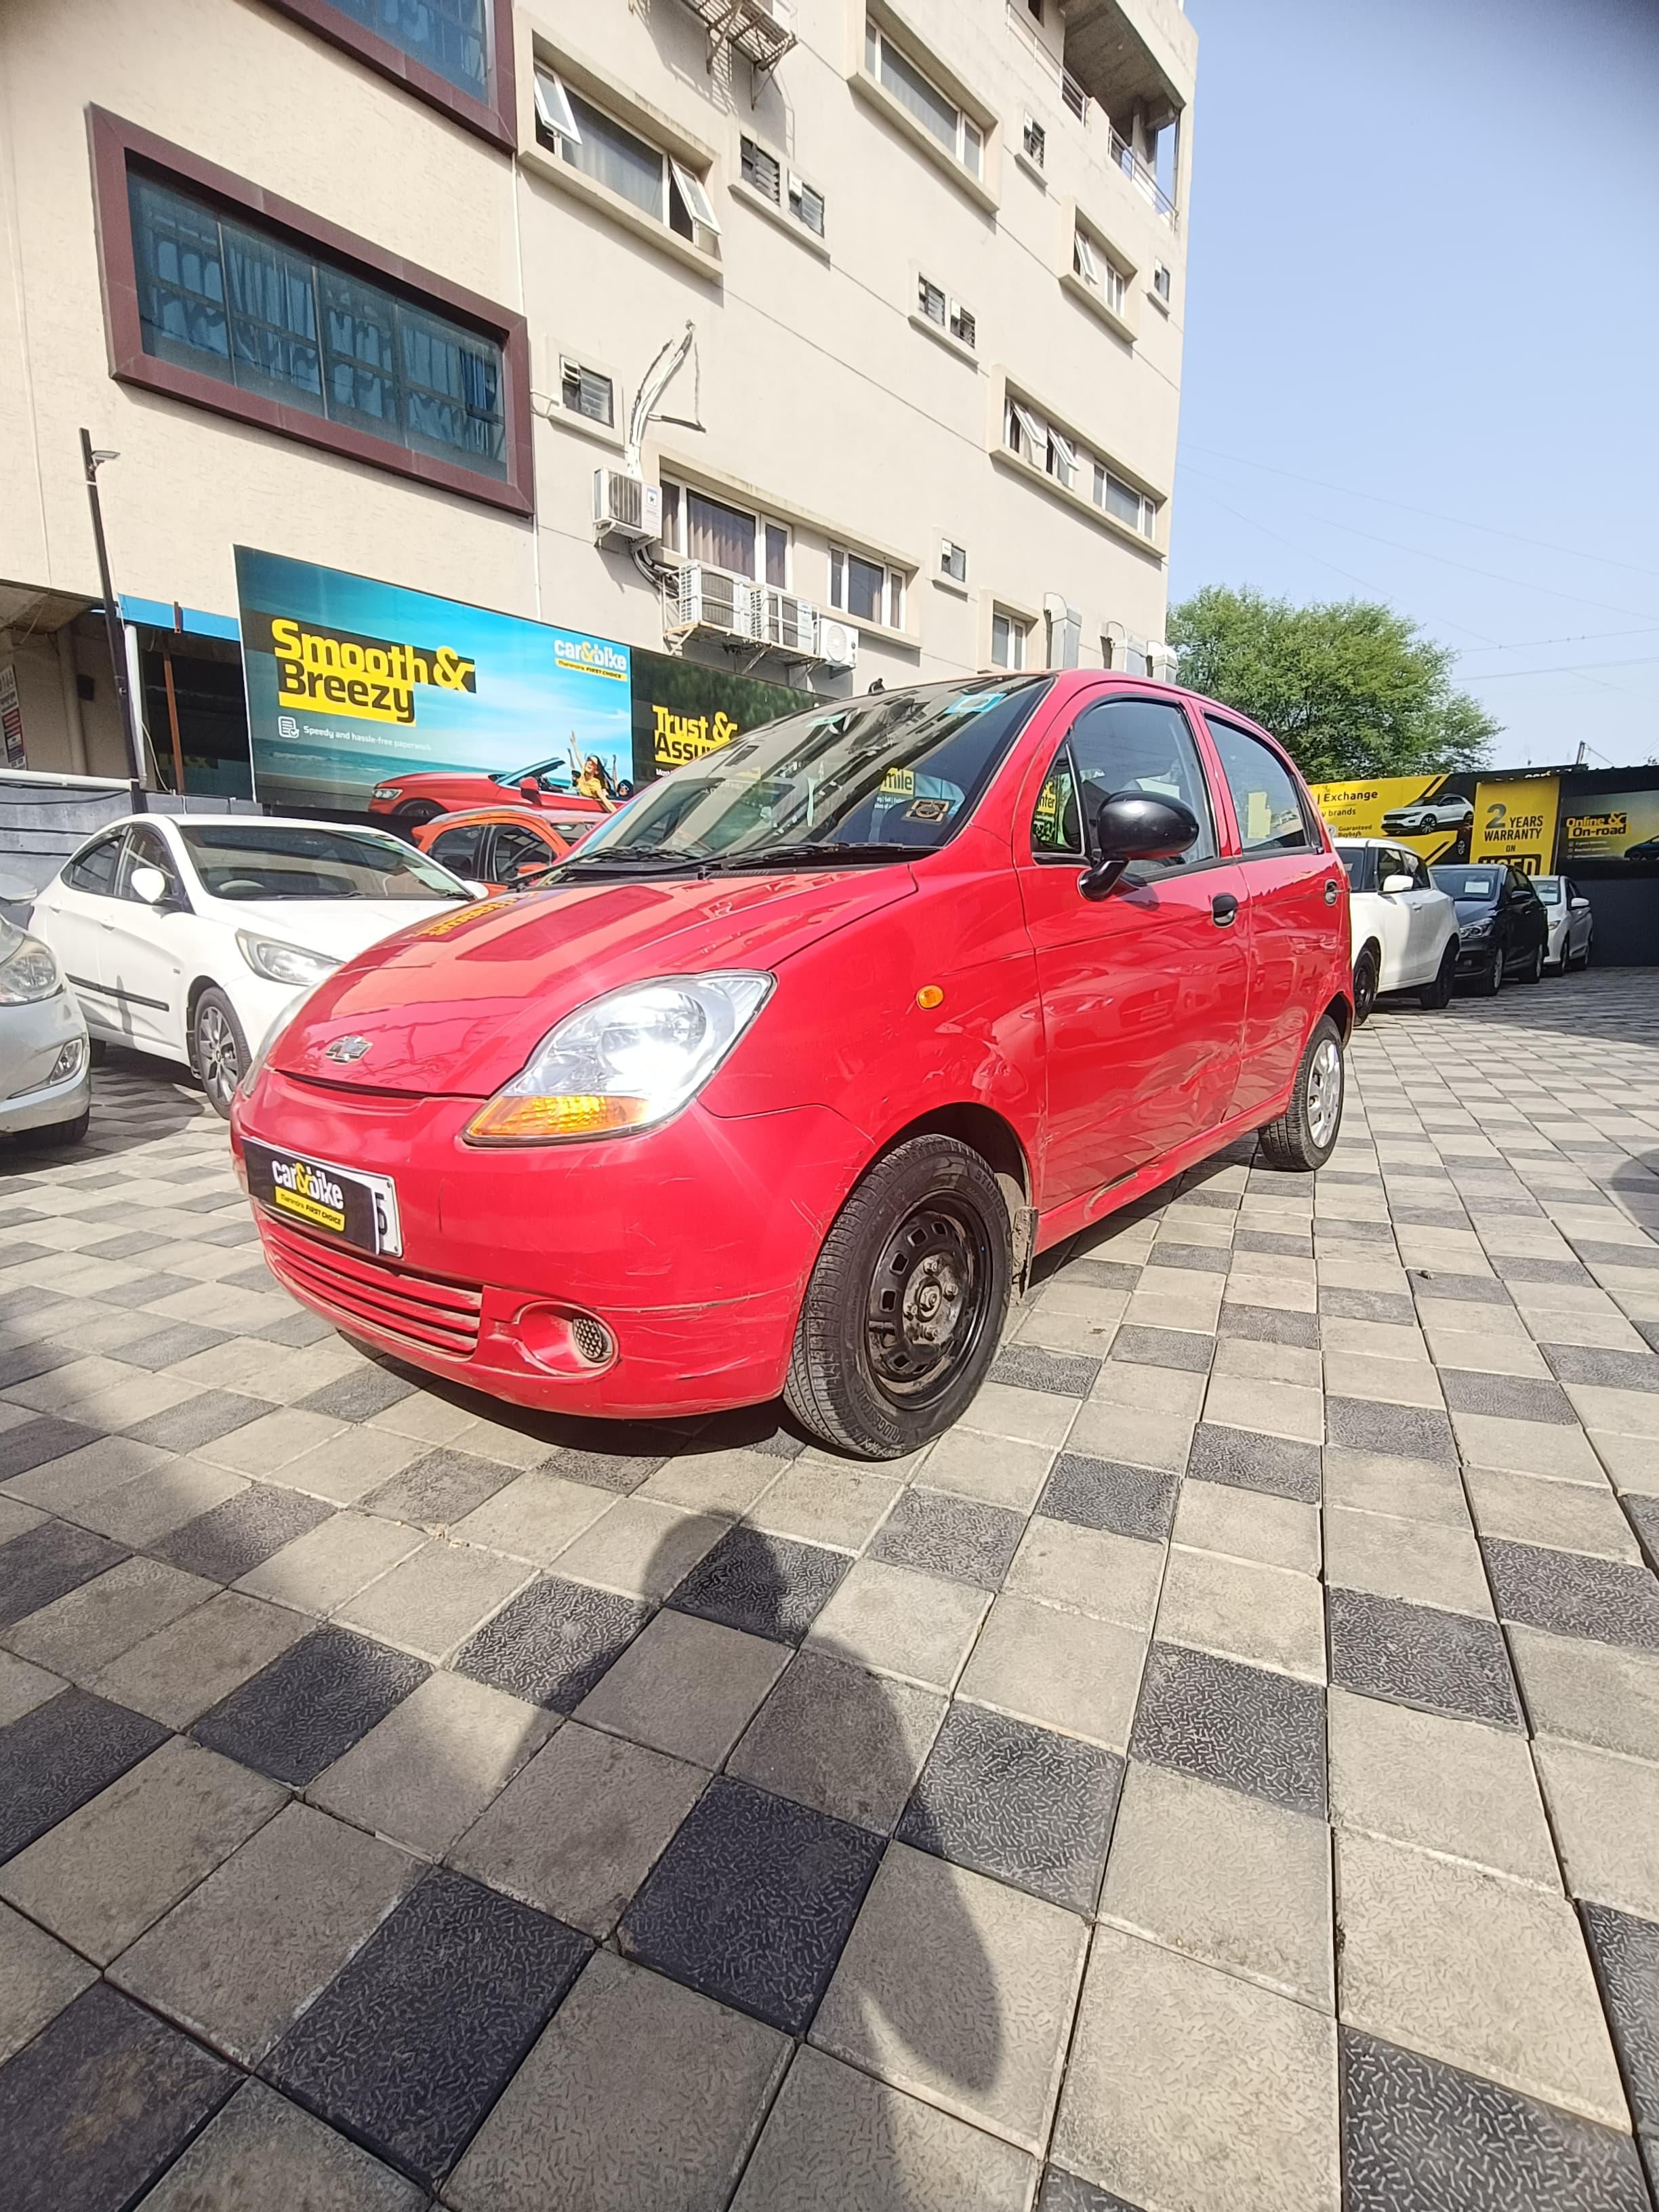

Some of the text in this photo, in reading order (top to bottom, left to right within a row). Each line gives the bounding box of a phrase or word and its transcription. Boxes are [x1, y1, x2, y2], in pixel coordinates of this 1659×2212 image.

[272, 619, 476, 692] Smooth &
[554, 639, 627, 671] car&bike
[277, 658, 415, 723] Breezy
[652, 705, 738, 742] Trust &
[304, 725, 334, 739] Speedy
[335, 731, 350, 740] and
[352, 733, 393, 745] hassle-free
[656, 733, 711, 760] Assu
[884, 769, 912, 791] mile
[1324, 791, 1378, 801] Exchange
[1328, 807, 1357, 817] brands
[1486, 803, 1544, 829] 2 YEARS
[1565, 810, 1627, 827] Online &
[1484, 828, 1542, 842] WARRANTY
[1572, 824, 1626, 837] On-road
[272, 1160, 344, 1210] car&bike
[306, 1204, 321, 1216] FIRST
[321, 1211, 342, 1225] CHOICE
